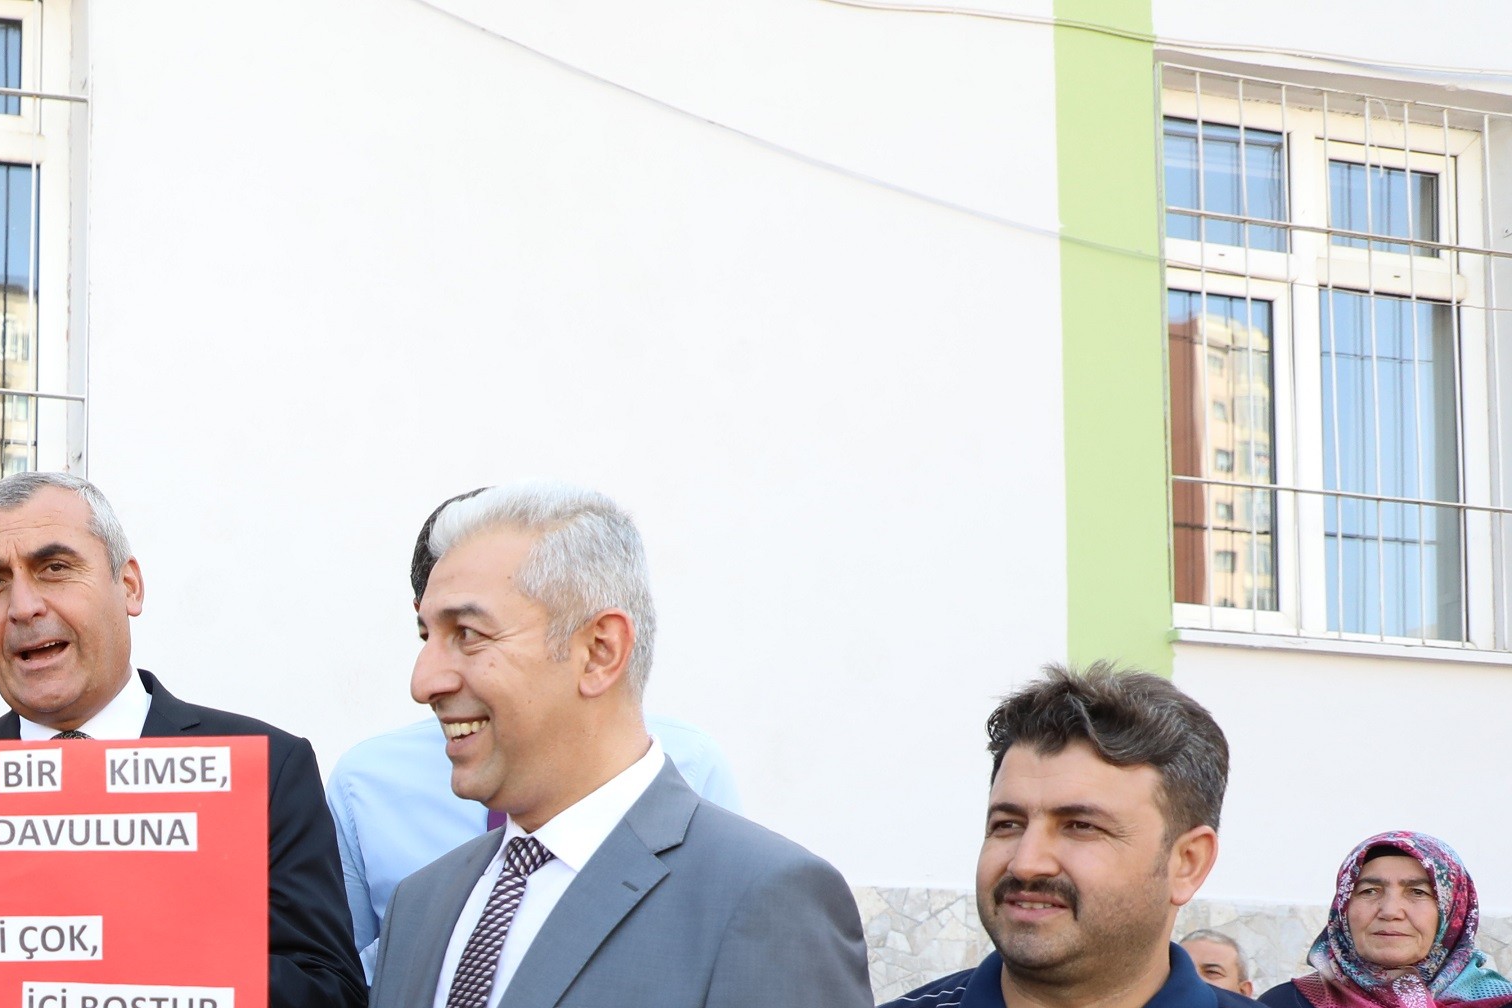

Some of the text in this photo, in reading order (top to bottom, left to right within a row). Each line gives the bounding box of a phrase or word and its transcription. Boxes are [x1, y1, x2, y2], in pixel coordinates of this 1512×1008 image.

[3, 753, 57, 788] BİR
[110, 751, 229, 788] KİMSE,
[18, 924, 99, 960] ÇOK,
